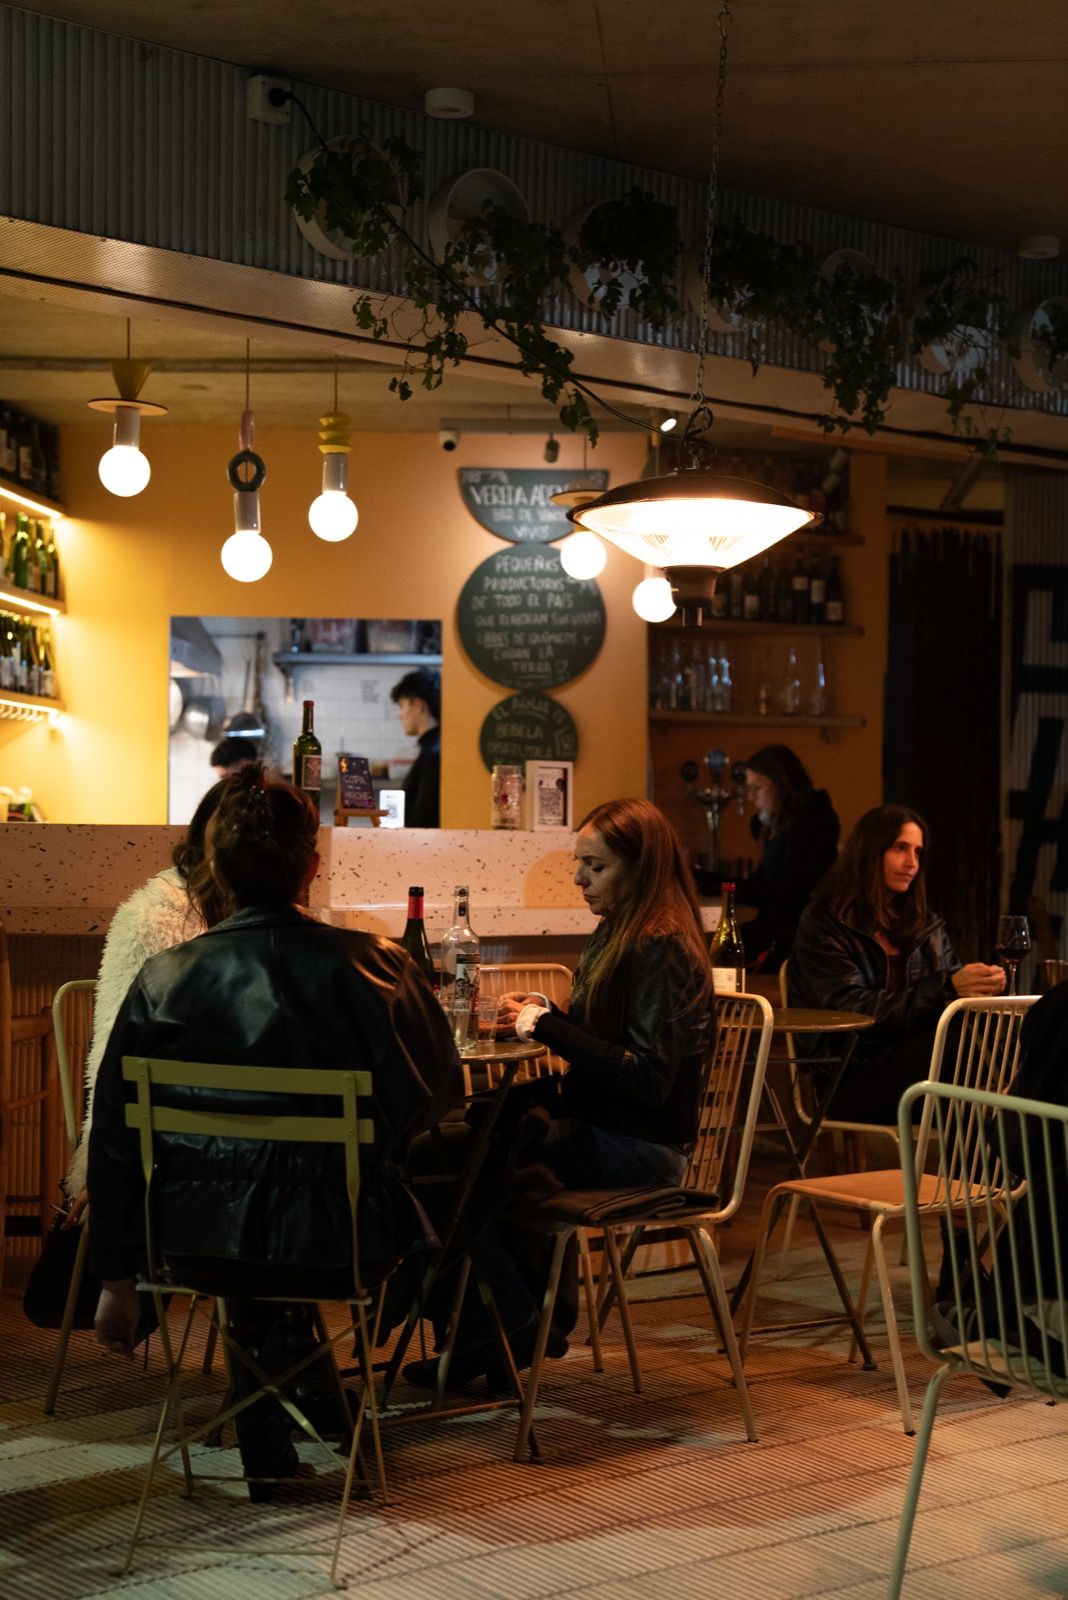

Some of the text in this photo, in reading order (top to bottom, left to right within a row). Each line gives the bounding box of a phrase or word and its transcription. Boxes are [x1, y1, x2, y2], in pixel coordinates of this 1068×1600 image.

[471, 595, 488, 610] DE
[492, 593, 523, 608] TODO
[527, 593, 540, 607] EL
[474, 614, 495, 627] QUE
[499, 612, 550, 626] ELABORAN
